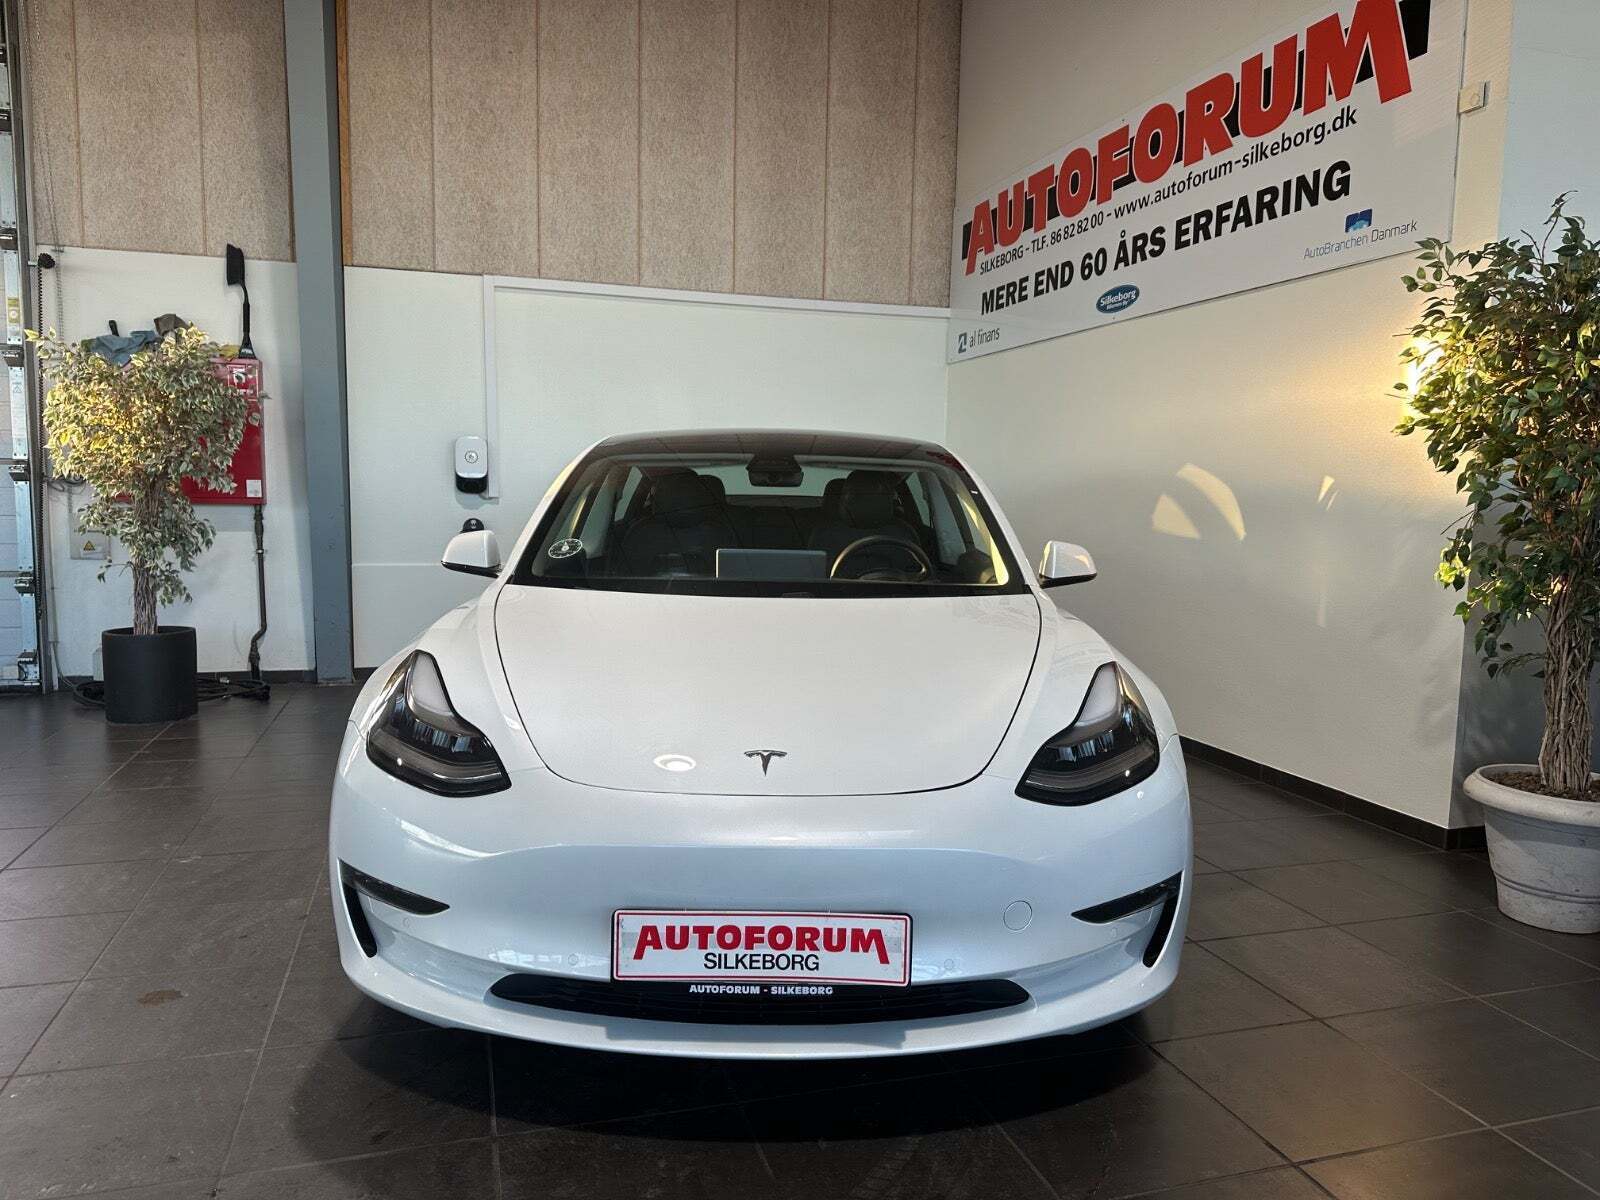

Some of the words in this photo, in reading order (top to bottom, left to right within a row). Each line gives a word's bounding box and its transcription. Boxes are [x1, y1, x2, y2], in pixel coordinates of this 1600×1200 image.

[965, 0, 1412, 276] AUTOFORUM
[980, 245, 1024, 275] SILKEBORG
[1031, 235, 1049, 253] TLF.
[1050, 229, 1062, 245] 86
[1063, 223, 1075, 240] 82
[1076, 217, 1089, 234] 82
[1090, 211, 1104, 228] 00
[1114, 105, 1357, 219] www.autoforum-silkeborg.dk
[981, 275, 1029, 315] MERE
[1034, 260, 1074, 297] END
[1080, 248, 1107, 281] 60
[1114, 229, 1166, 270] ÅRS
[1174, 160, 1351, 251] ERFARING
[1304, 234, 1368, 259] AutoBranchen
[1371, 219, 1418, 242] Danmark
[1100, 290, 1136, 306] Silkeborg
[633, 924, 890, 964] AUTOFORUM
[704, 952, 819, 971] SILKEBORG
[689, 984, 760, 994] AUTOFORUM
[770, 986, 833, 995] SILKEBORG
